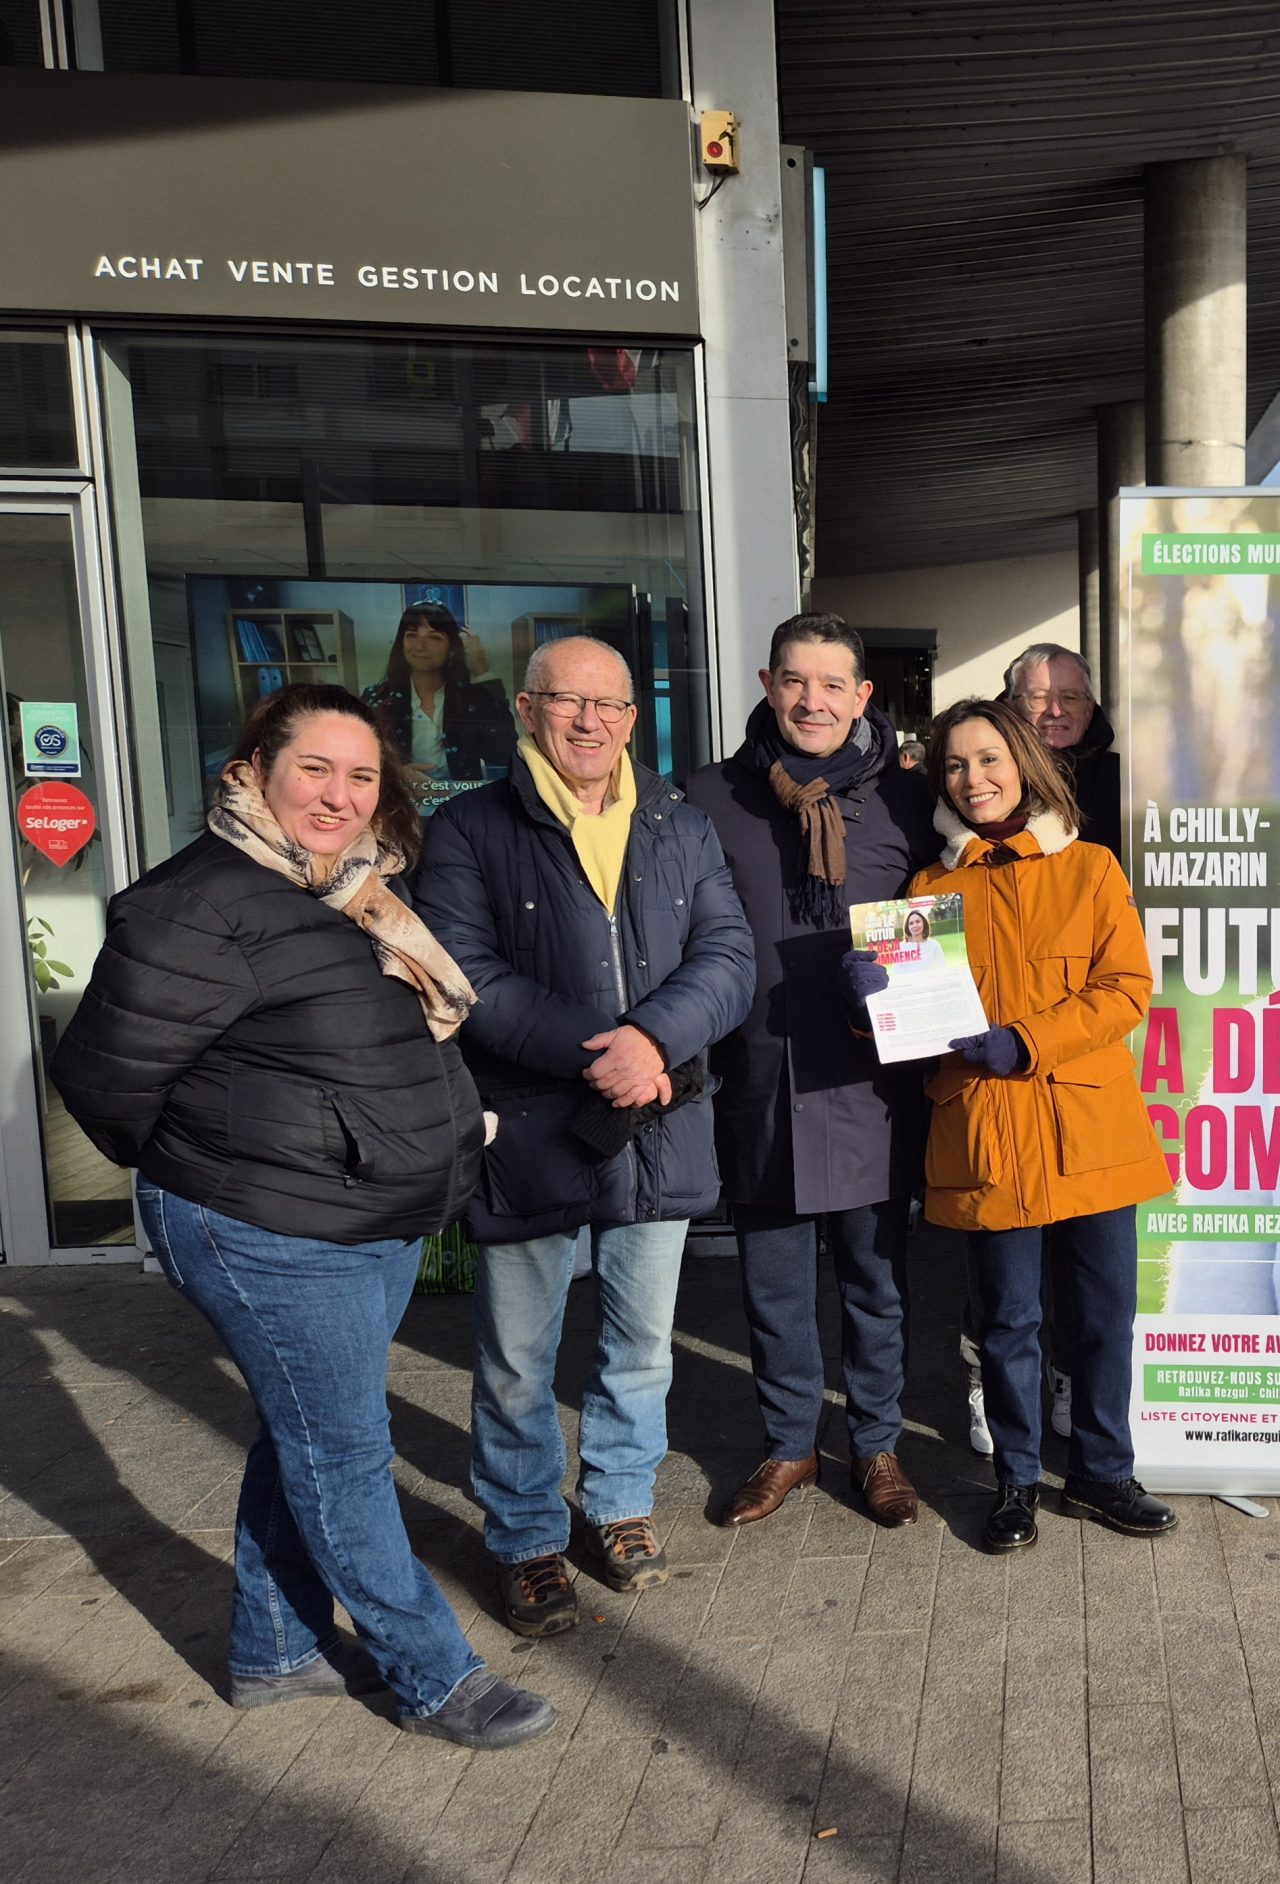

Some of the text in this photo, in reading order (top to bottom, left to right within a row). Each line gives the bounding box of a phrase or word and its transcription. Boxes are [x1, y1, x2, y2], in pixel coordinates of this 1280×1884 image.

[95, 256, 680, 302] ACHAT VENTE GESTION LOCATION
[1153, 540, 1241, 564] ÉLECTIONS
[421, 780, 450, 791] c'est
[25, 817, 82, 832] SeLoger
[1144, 799, 1270, 843] À CHILLY-
[1144, 852, 1267, 887] MAZARIN
[1140, 1007, 1184, 1094] A
[1147, 1213, 1188, 1233] AVEC
[1193, 1213, 1249, 1234] RAFIKA
[1145, 1333, 1206, 1352] DONNEZ
[1211, 1334, 1260, 1353] VOTRE
[1157, 1370, 1262, 1385] RETROUVEZ-NOUS
[1178, 1386, 1211, 1398] Rafika
[1214, 1387, 1249, 1400] Rezgui
[1141, 1411, 1177, 1422] LISTE
[1181, 1412, 1257, 1423] CITOYENNE
[1262, 1414, 1278, 1424] ET
